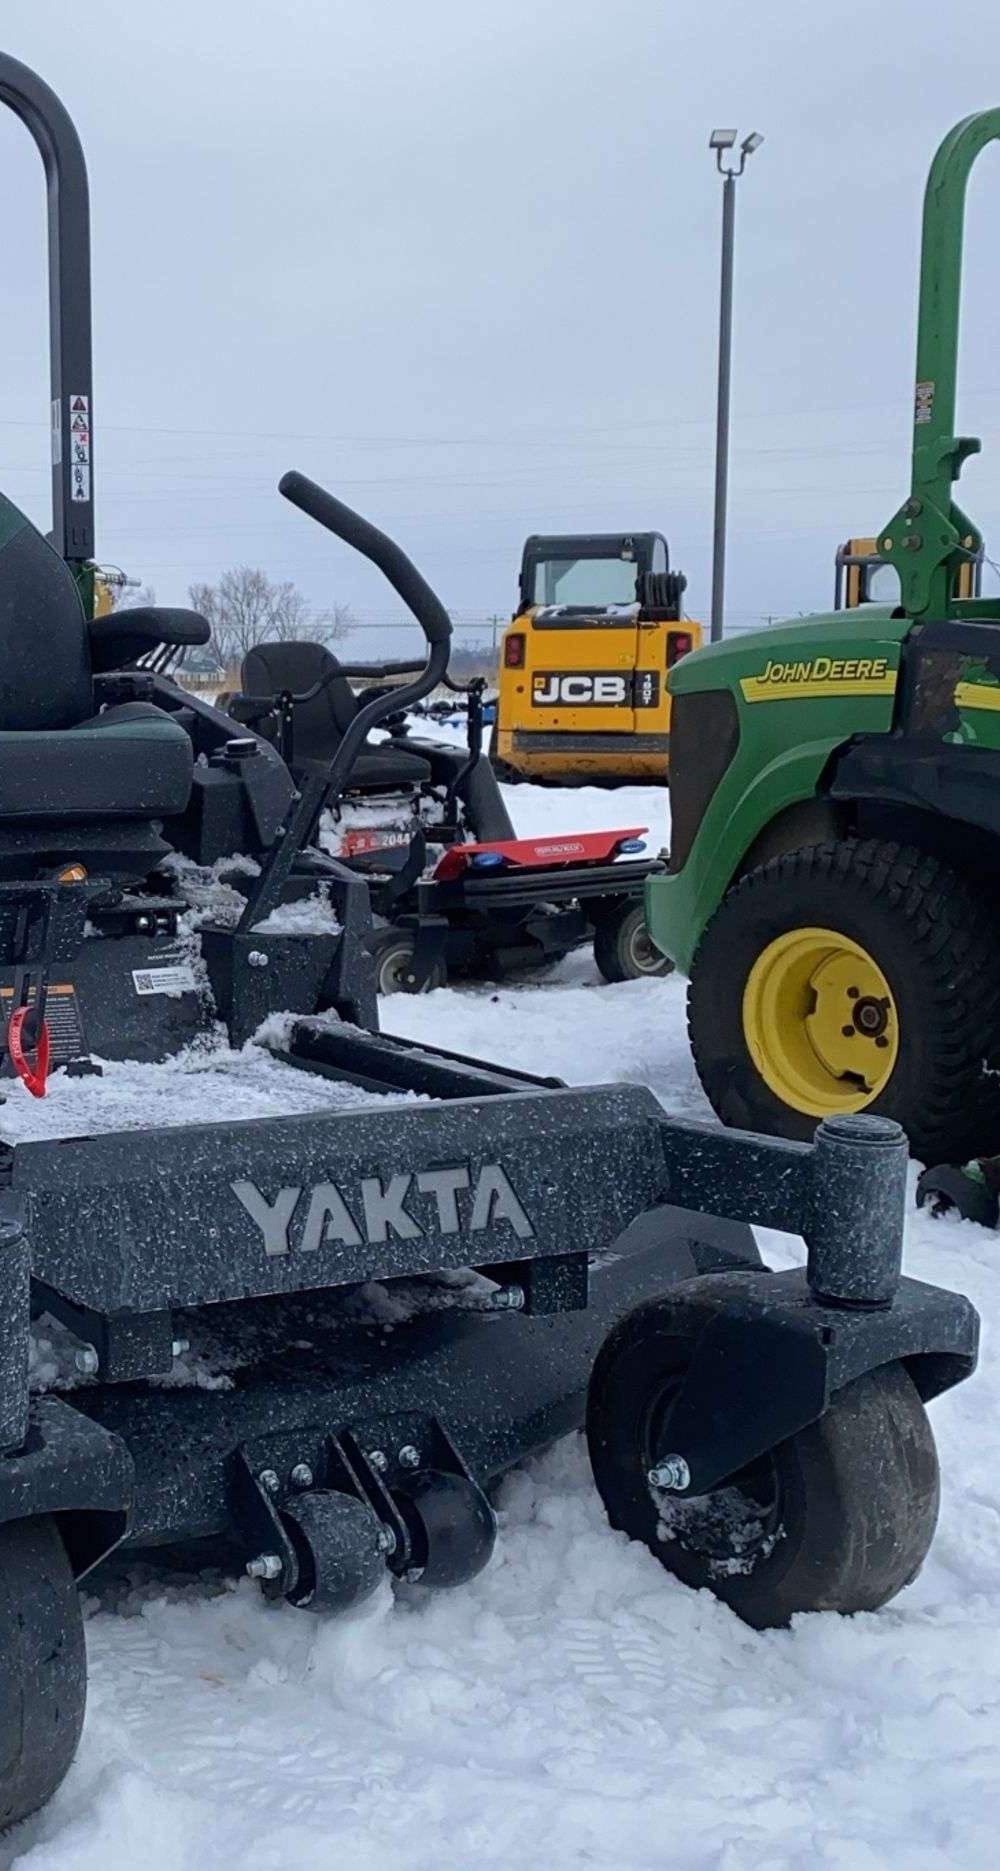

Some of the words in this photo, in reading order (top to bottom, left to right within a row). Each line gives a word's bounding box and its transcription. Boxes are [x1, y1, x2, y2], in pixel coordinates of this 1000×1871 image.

[757, 660, 812, 683] JOHN
[811, 657, 888, 682] DEERE
[533, 676, 626, 702] JCB
[230, 1164, 537, 1256] YAKTA
